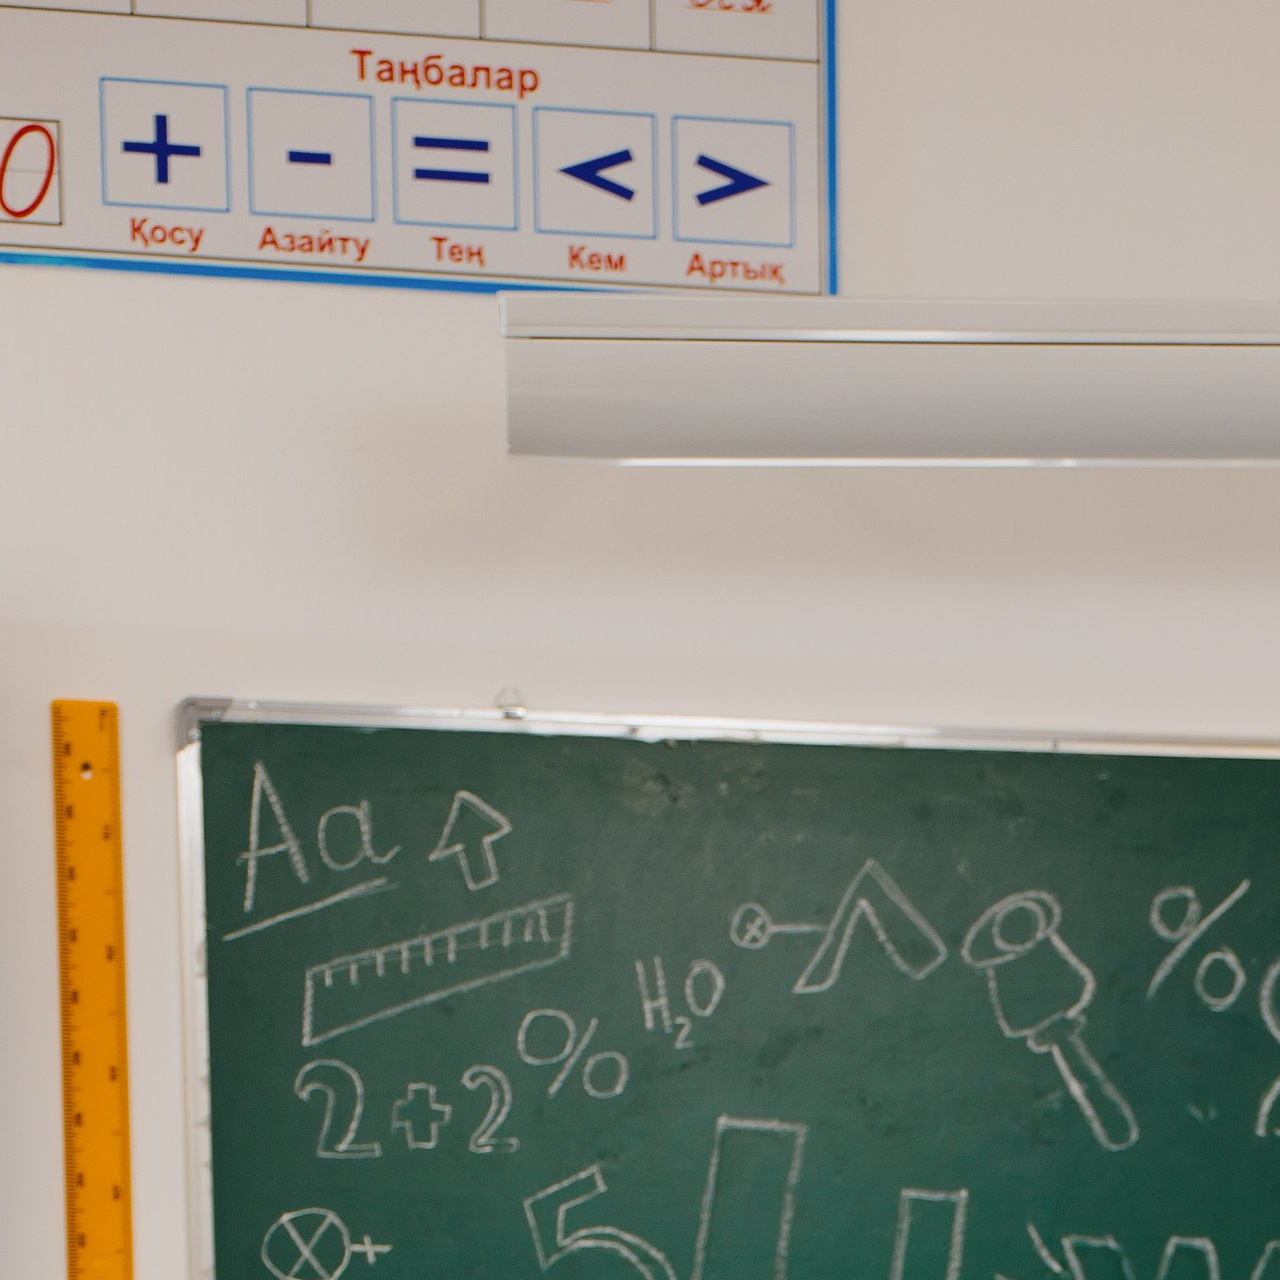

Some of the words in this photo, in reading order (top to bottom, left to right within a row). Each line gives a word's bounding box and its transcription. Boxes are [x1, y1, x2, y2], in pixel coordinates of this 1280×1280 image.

[350, 49, 539, 99] Таңбалар
[129, 218, 204, 251] Қосу
[259, 227, 370, 261] Азайту
[431, 237, 485, 267] Тең
[568, 246, 626, 271] Кем
[687, 253, 784, 283] Артық
